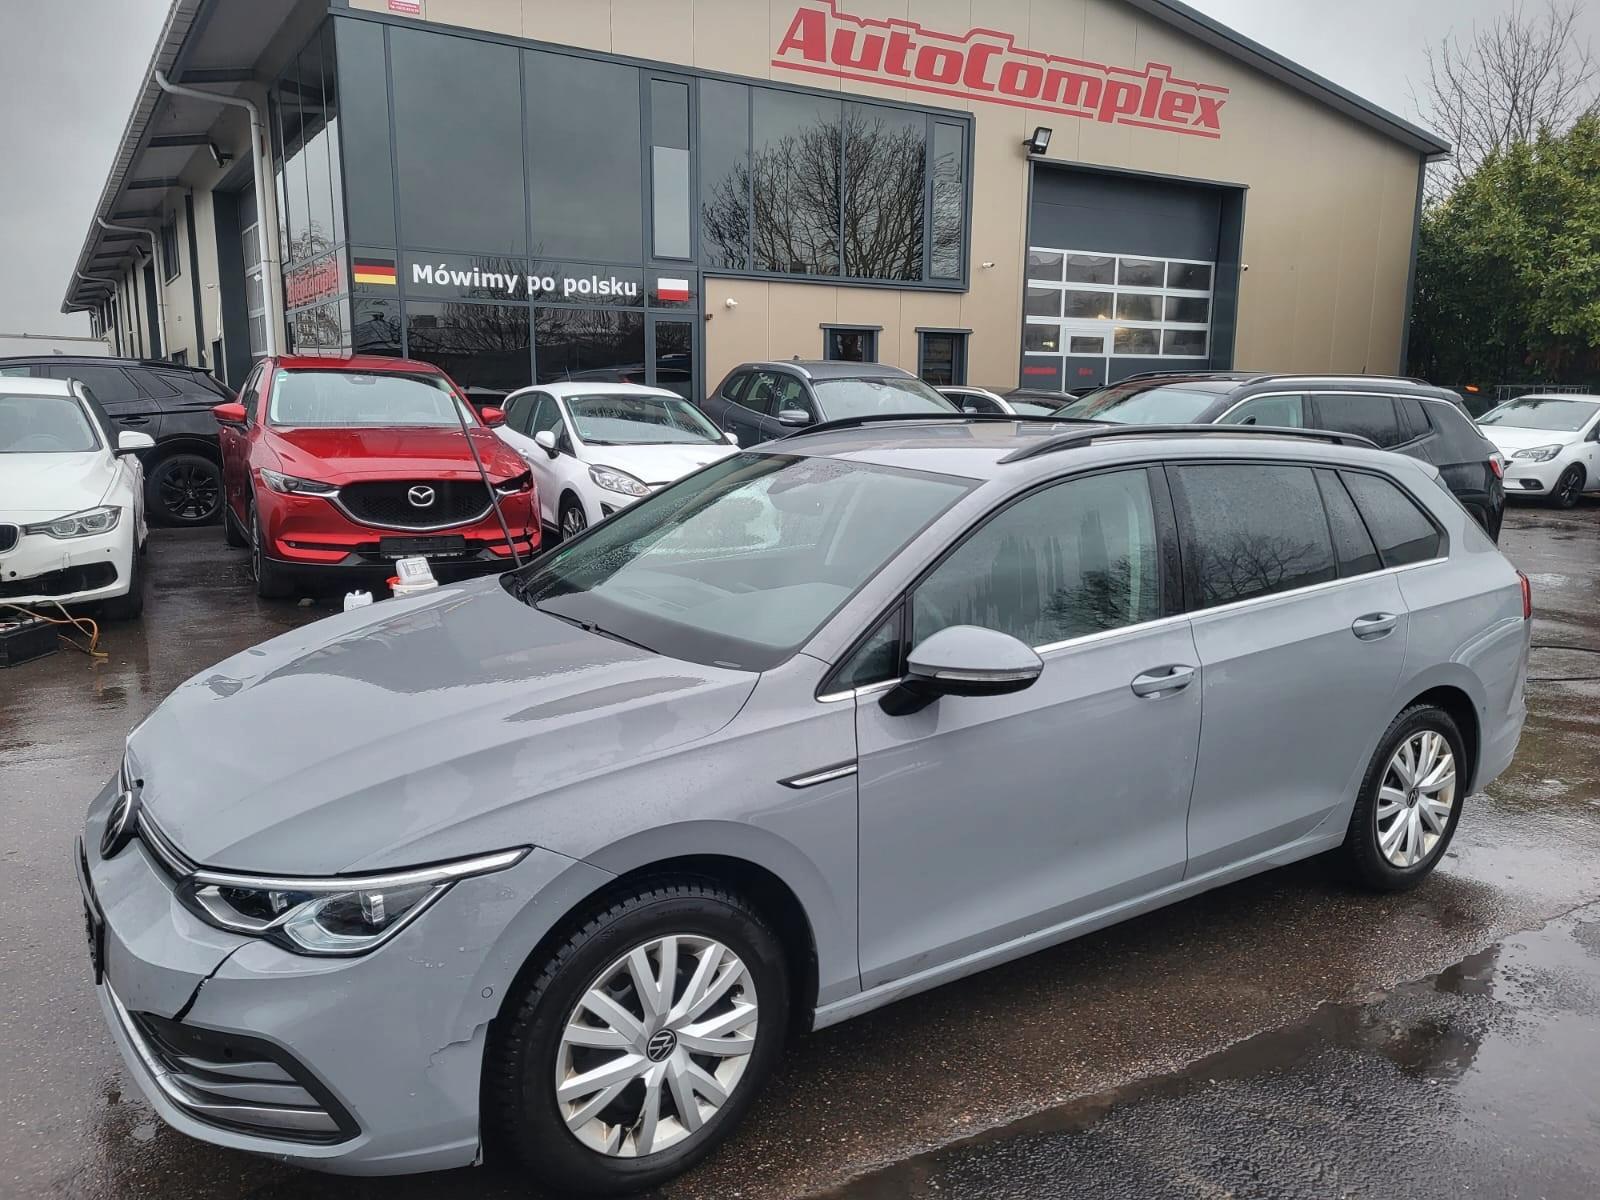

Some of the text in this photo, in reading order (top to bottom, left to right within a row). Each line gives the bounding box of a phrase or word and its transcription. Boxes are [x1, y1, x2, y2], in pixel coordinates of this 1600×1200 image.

[777, 7, 1227, 130] AutoComplex
[411, 263, 638, 297] Mówimy po polsku
